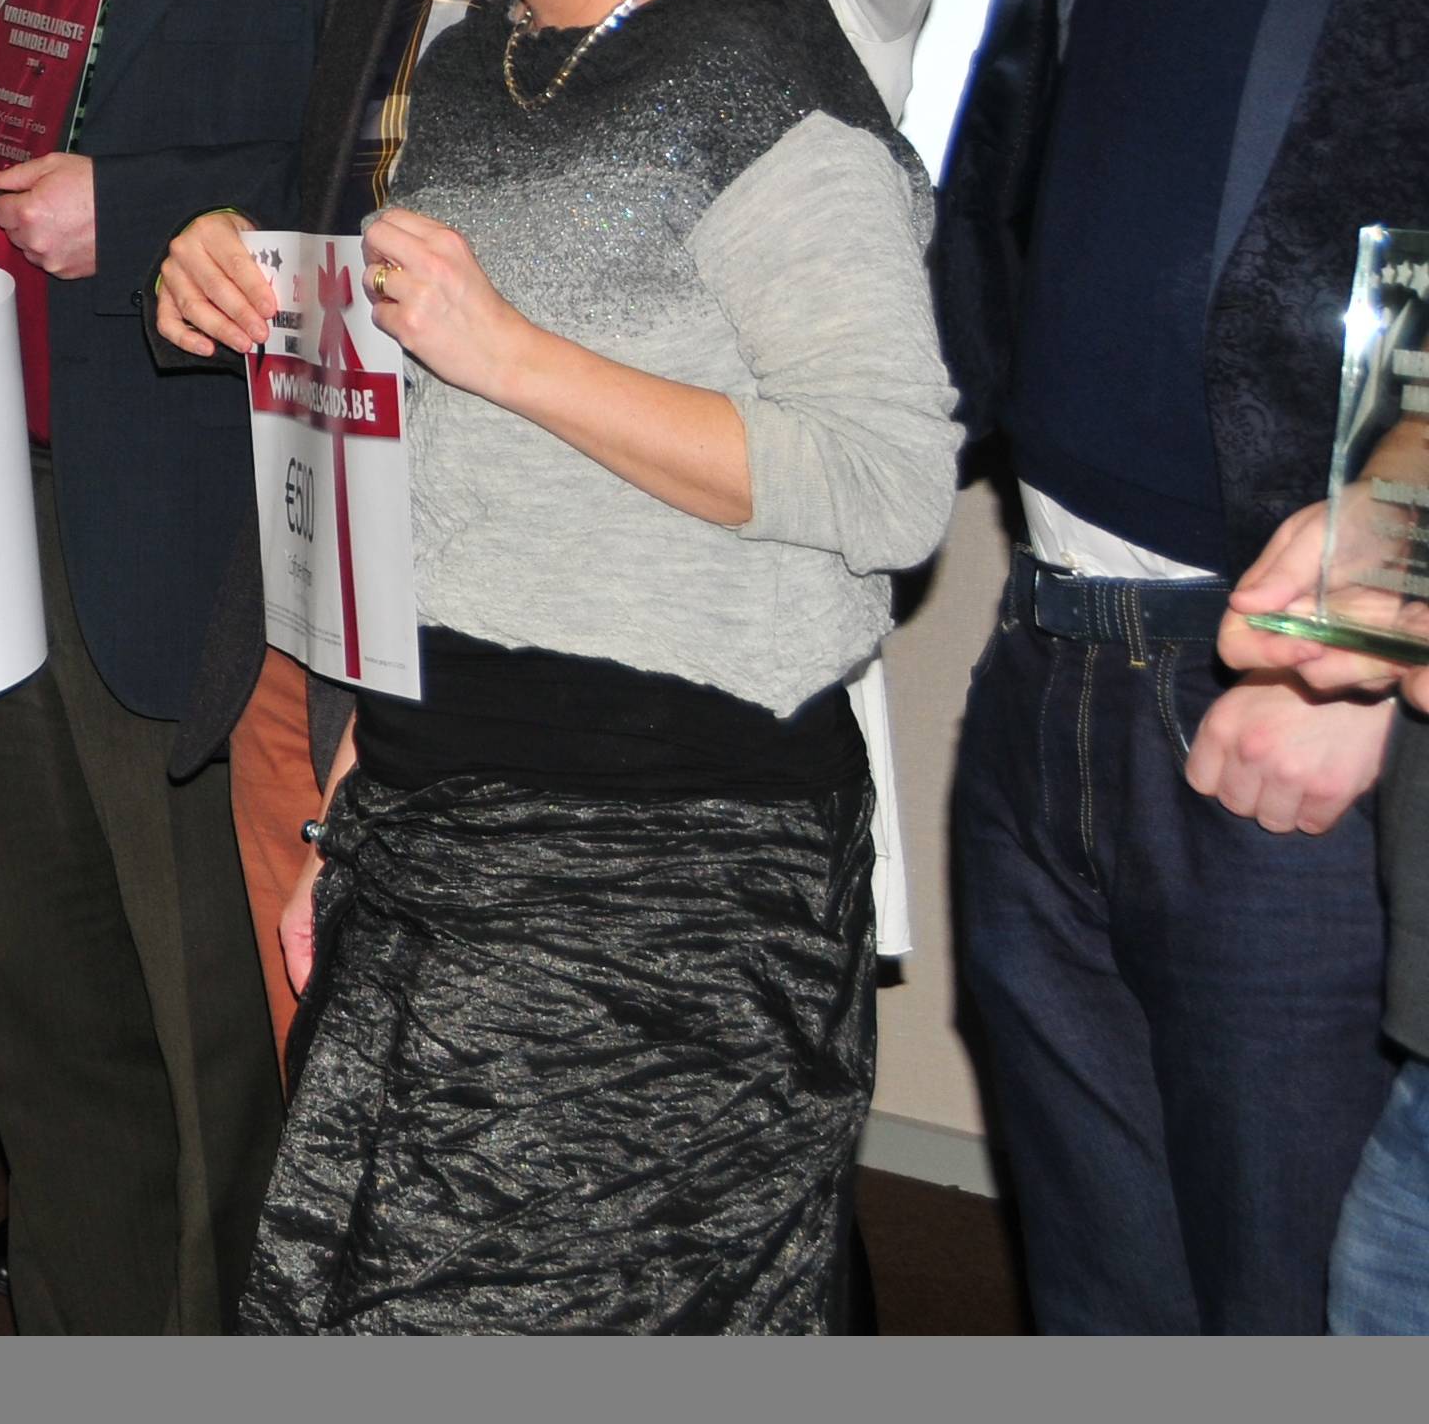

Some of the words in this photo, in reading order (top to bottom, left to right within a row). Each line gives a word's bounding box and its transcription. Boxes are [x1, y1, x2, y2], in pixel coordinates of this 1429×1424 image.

[3, 4, 86, 42] VRIENDELIJKSTE
[8, 28, 70, 59] HANDELAAR
[26, 118, 46, 134] Foto
